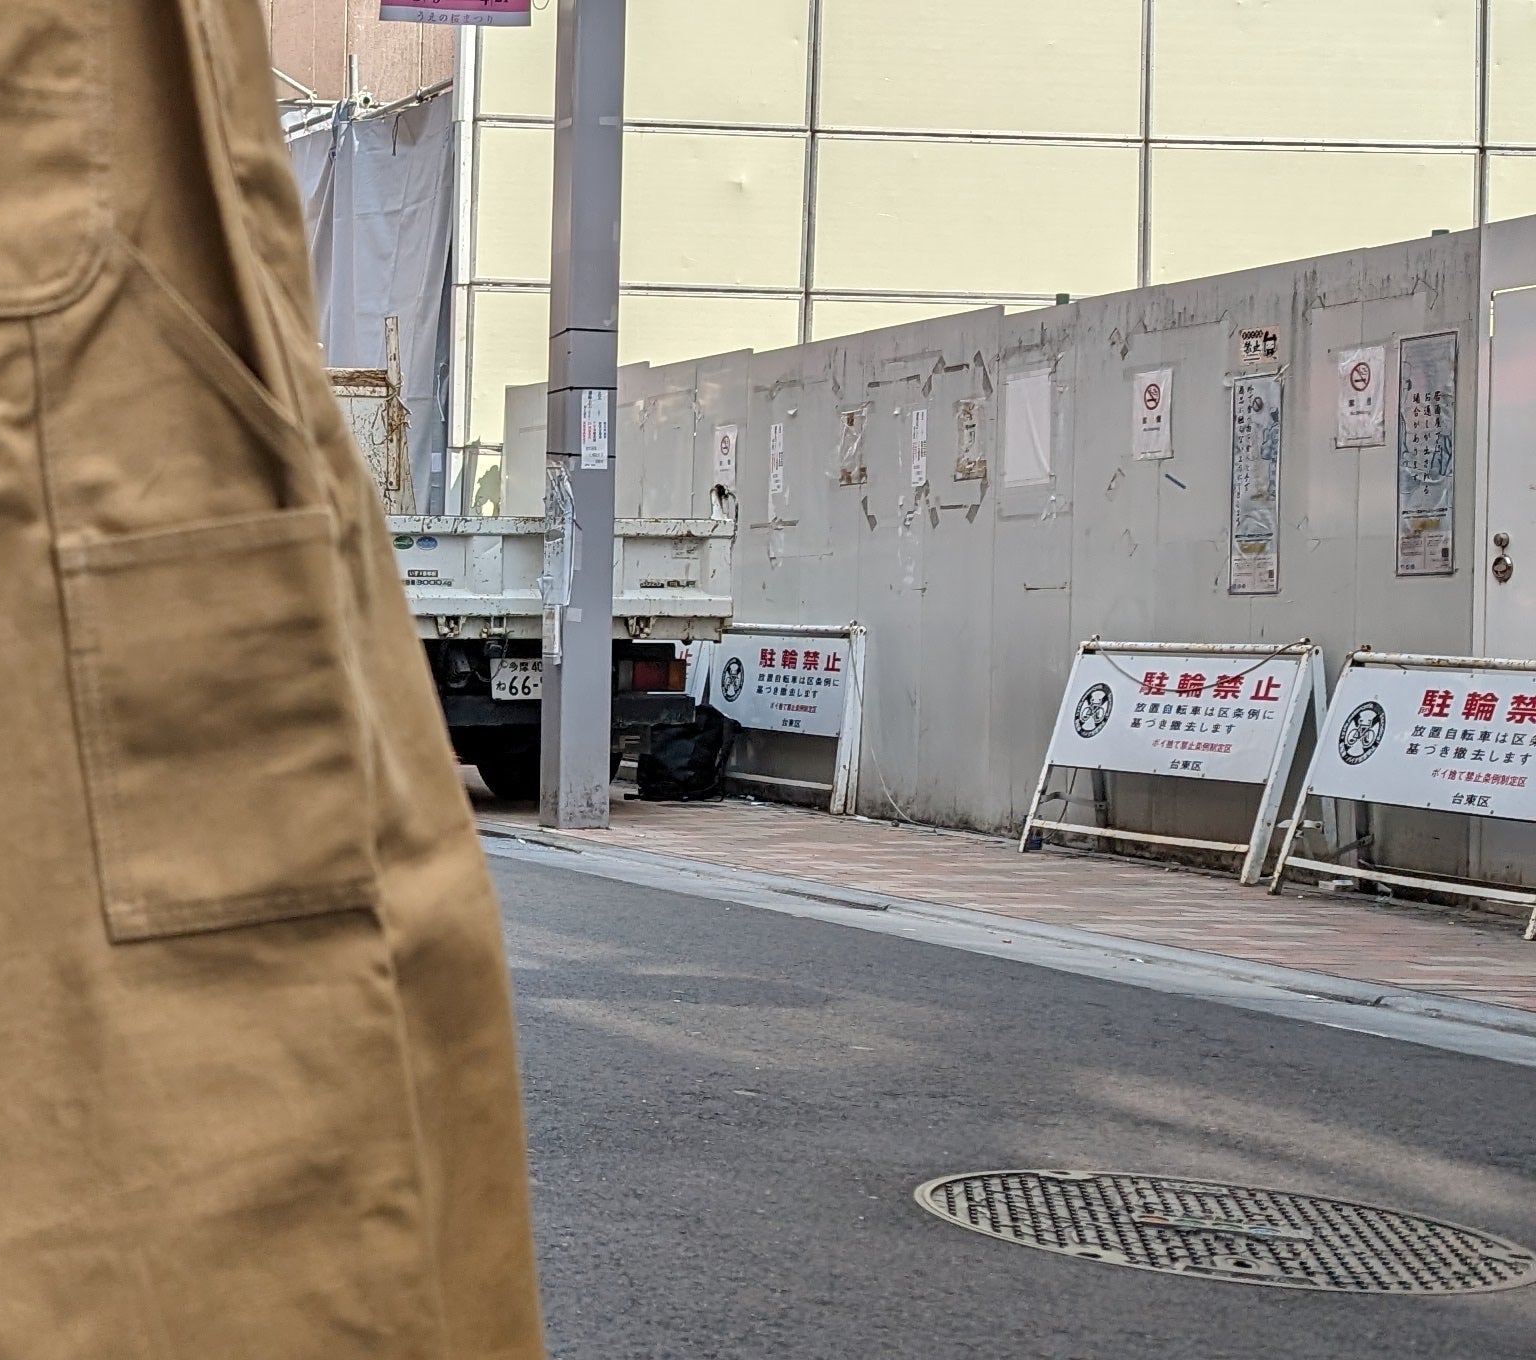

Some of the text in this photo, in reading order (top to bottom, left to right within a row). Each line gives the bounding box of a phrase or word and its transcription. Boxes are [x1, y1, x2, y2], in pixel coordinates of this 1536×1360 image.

[758, 648, 842, 672] 駐輪禁止
[508, 675, 543, 696] 66-
[1138, 671, 1282, 702] 駐輪禁止
[1134, 702, 1276, 721] 放置自転車は区条例に
[1130, 717, 1237, 735] 基づき撤去します
[1405, 742, 1533, 766] 基づき撤去します
[1169, 758, 1204, 772] 台東区
[1451, 792, 1492, 808] 台東区
